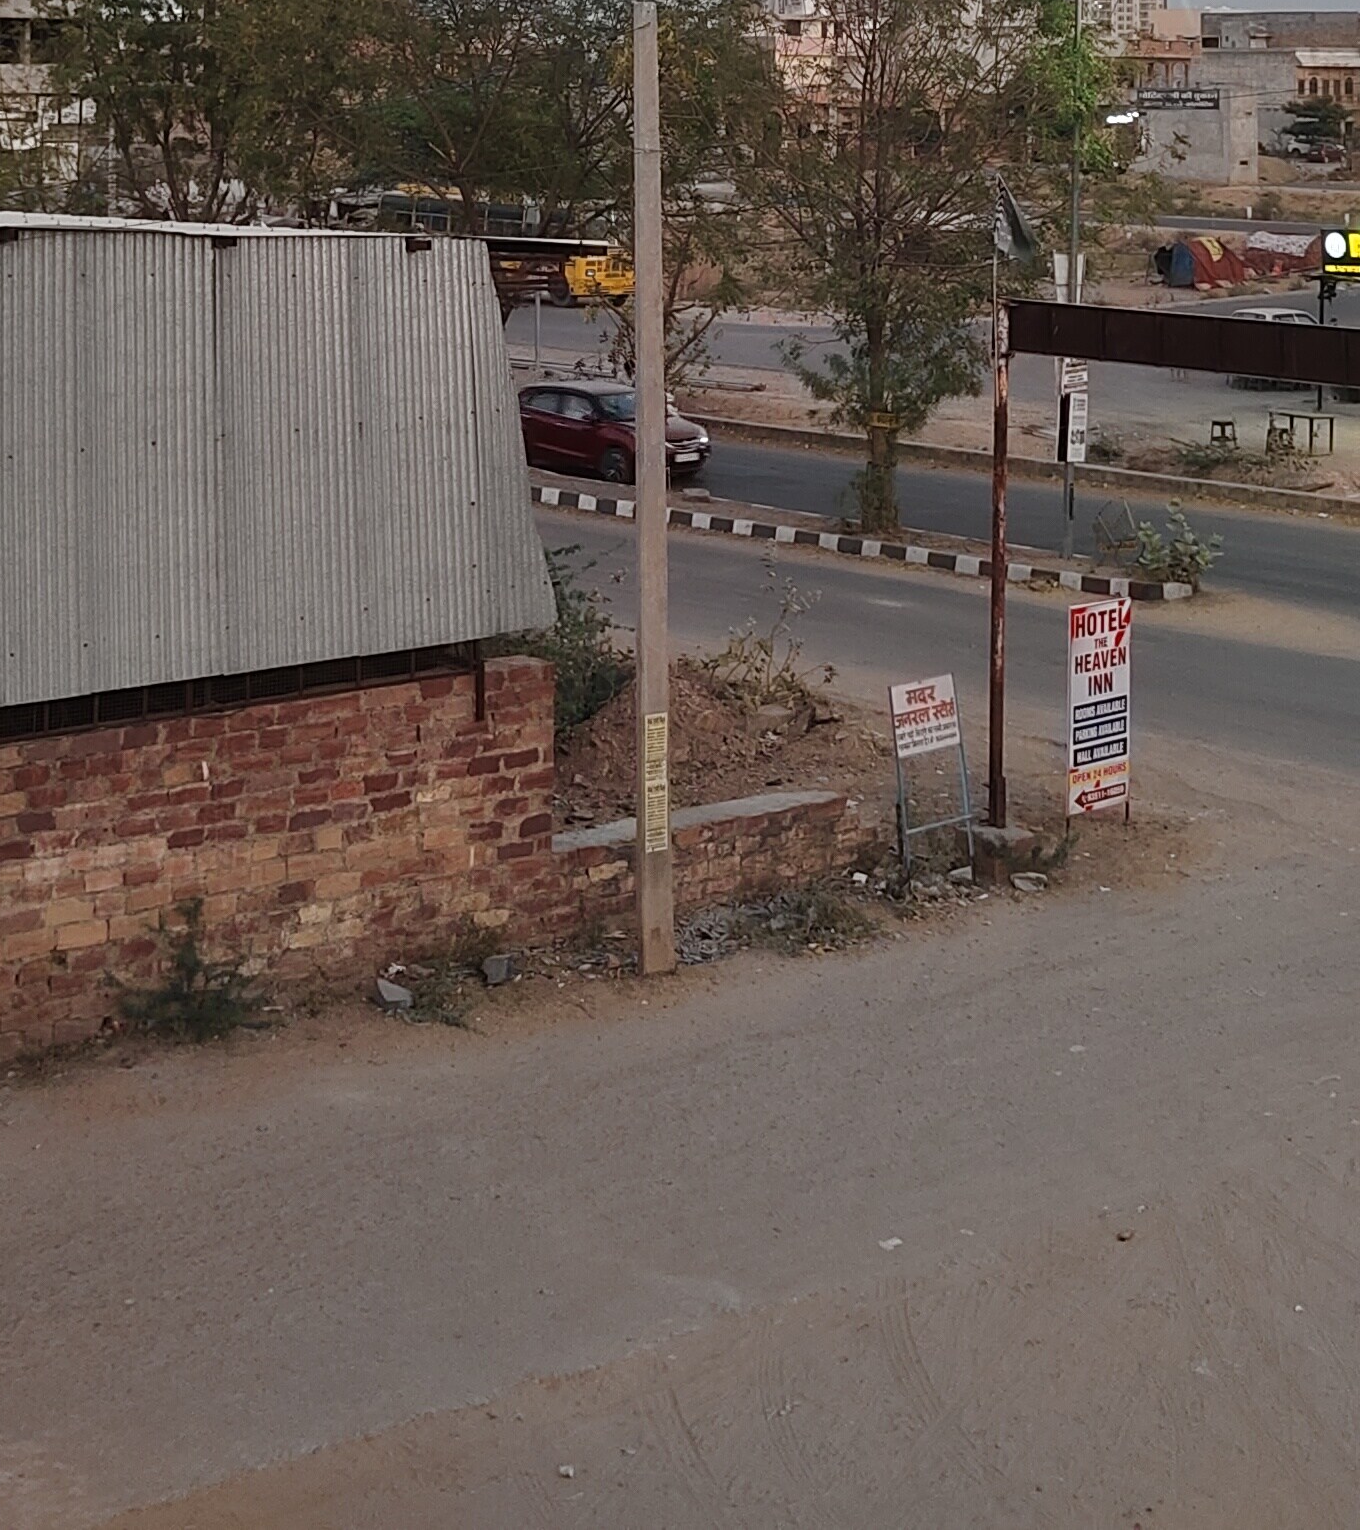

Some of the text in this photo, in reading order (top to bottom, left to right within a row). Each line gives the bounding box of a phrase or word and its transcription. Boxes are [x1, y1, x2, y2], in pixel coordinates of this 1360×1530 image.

[1075, 607, 1127, 638] HOTEL
[1094, 636, 1108, 649] THE
[1075, 646, 1126, 674] HEAVEN
[1088, 671, 1113, 697] INN
[894, 707, 930, 729] जनरल
[1075, 698, 1125, 720] ROOMS AVAILABLE
[1098, 719, 1124, 736] AVAILABLE
[1076, 741, 1124, 764] HALL AVAILABLE
[1073, 771, 1091, 784] OPEN
[1103, 761, 1126, 777] HOURS
